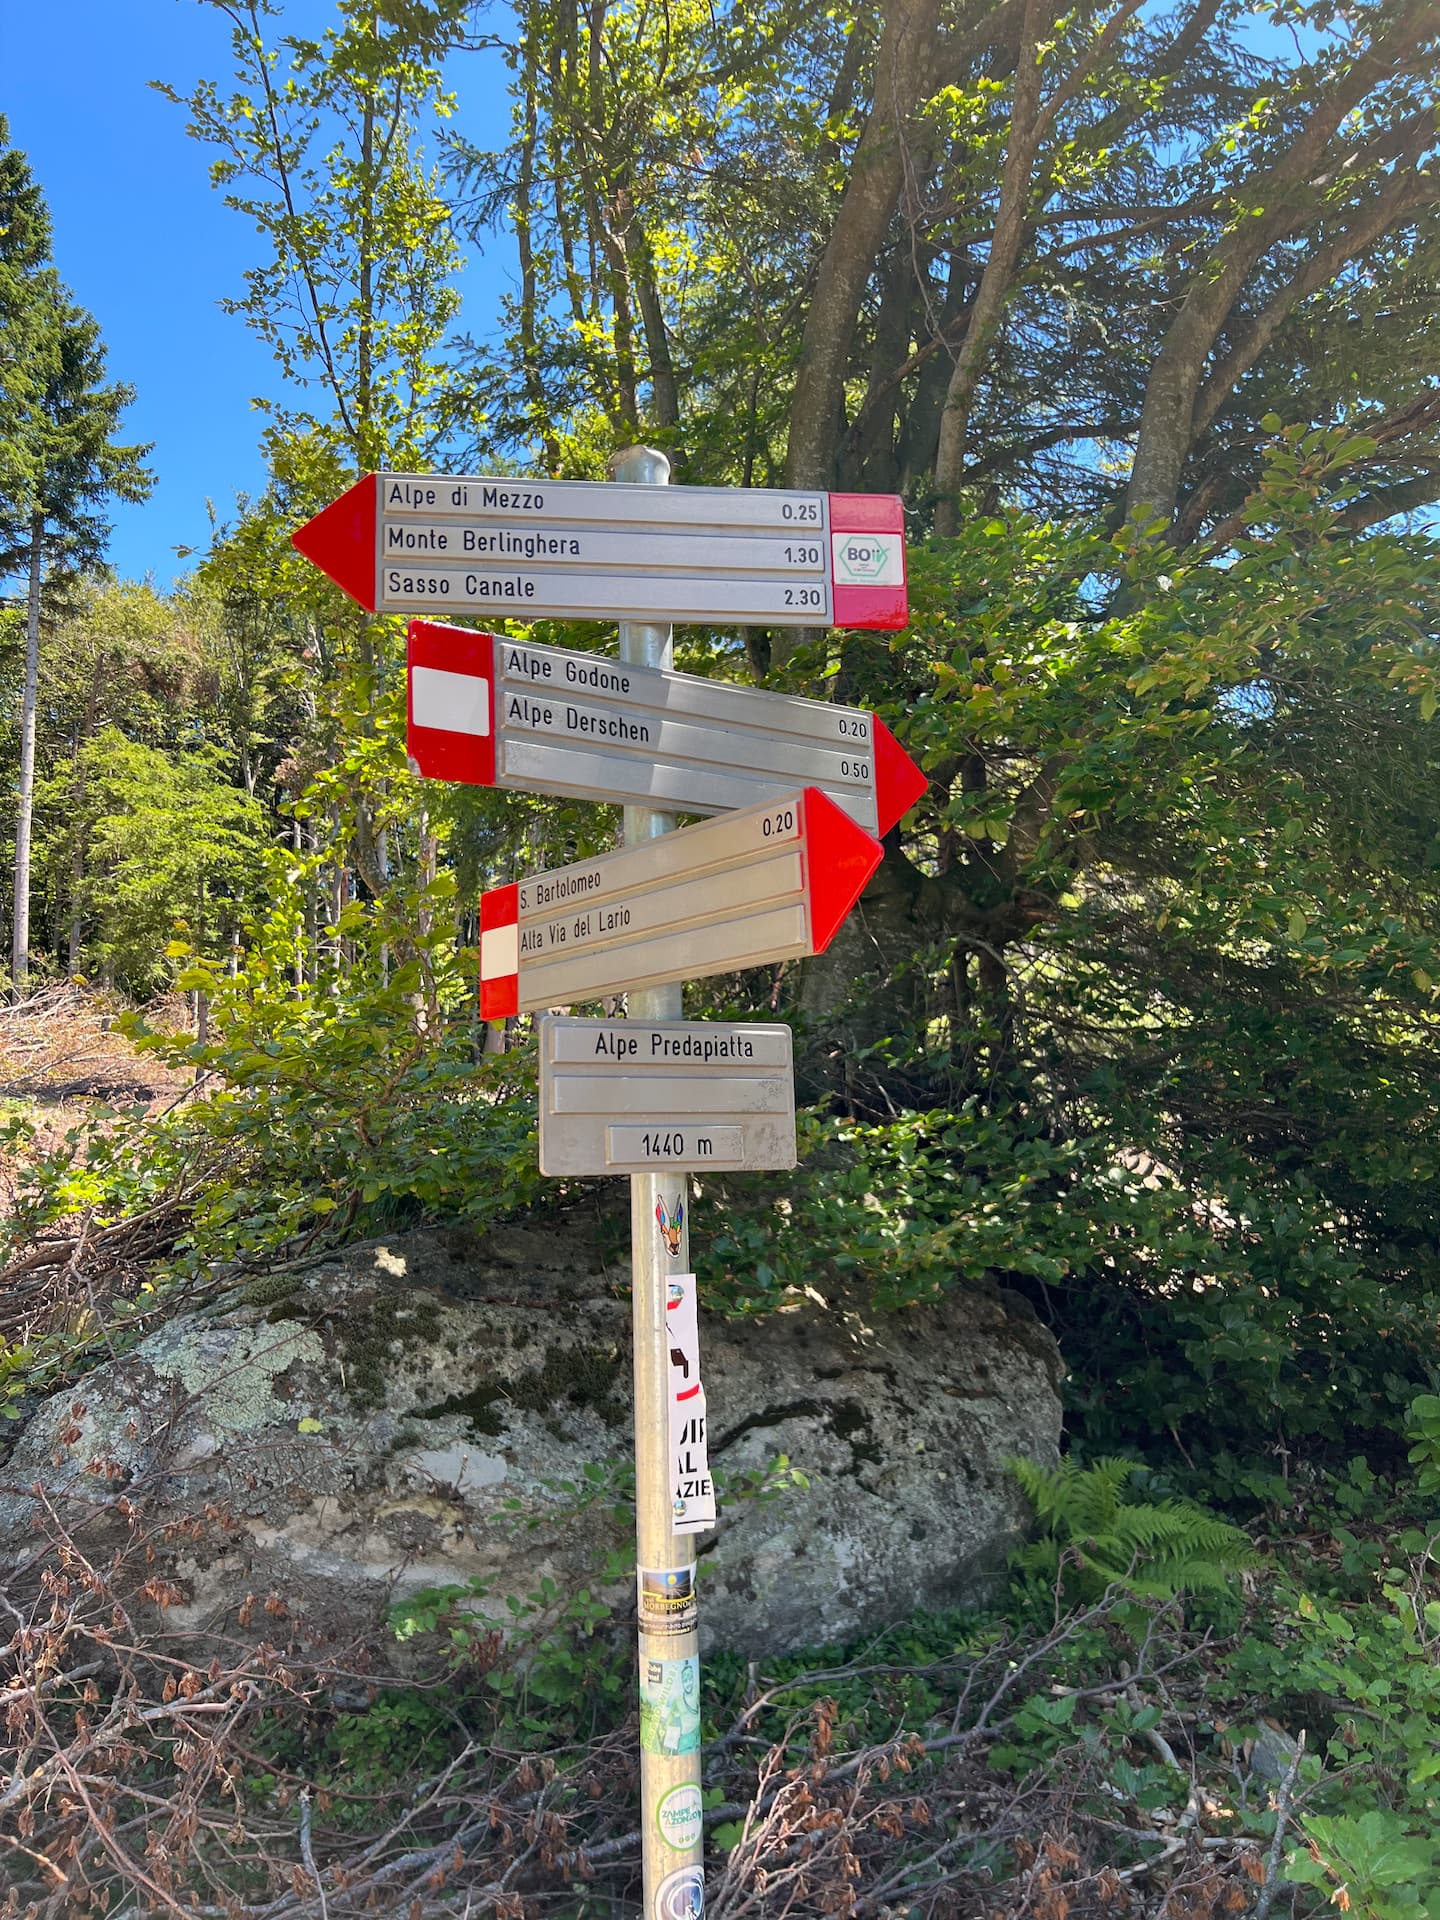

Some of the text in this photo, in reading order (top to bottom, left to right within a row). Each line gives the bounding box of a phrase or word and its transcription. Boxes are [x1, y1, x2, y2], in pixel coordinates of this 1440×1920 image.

[389, 483, 544, 510] Alpe di Mezzo
[782, 503, 817, 521] 0.25
[389, 527, 580, 558] Monte Berlinghera
[784, 547, 819, 564] 1.30
[389, 572, 535, 597] Sasso Canale
[784, 589, 821, 606] 2.30
[508, 650, 630, 694] Alpe Godone
[509, 697, 650, 742] Alpe Derschen
[839, 719, 867, 738] 0.20
[841, 760, 869, 779] 0.50
[763, 811, 793, 836] 0.20
[520, 872, 601, 909] S. Bartolomeo
[520, 905, 631, 952] Alta Via del Lario
[595, 1032, 753, 1062] Alpe Predapiatta
[642, 1133, 713, 1156] 1440 m
